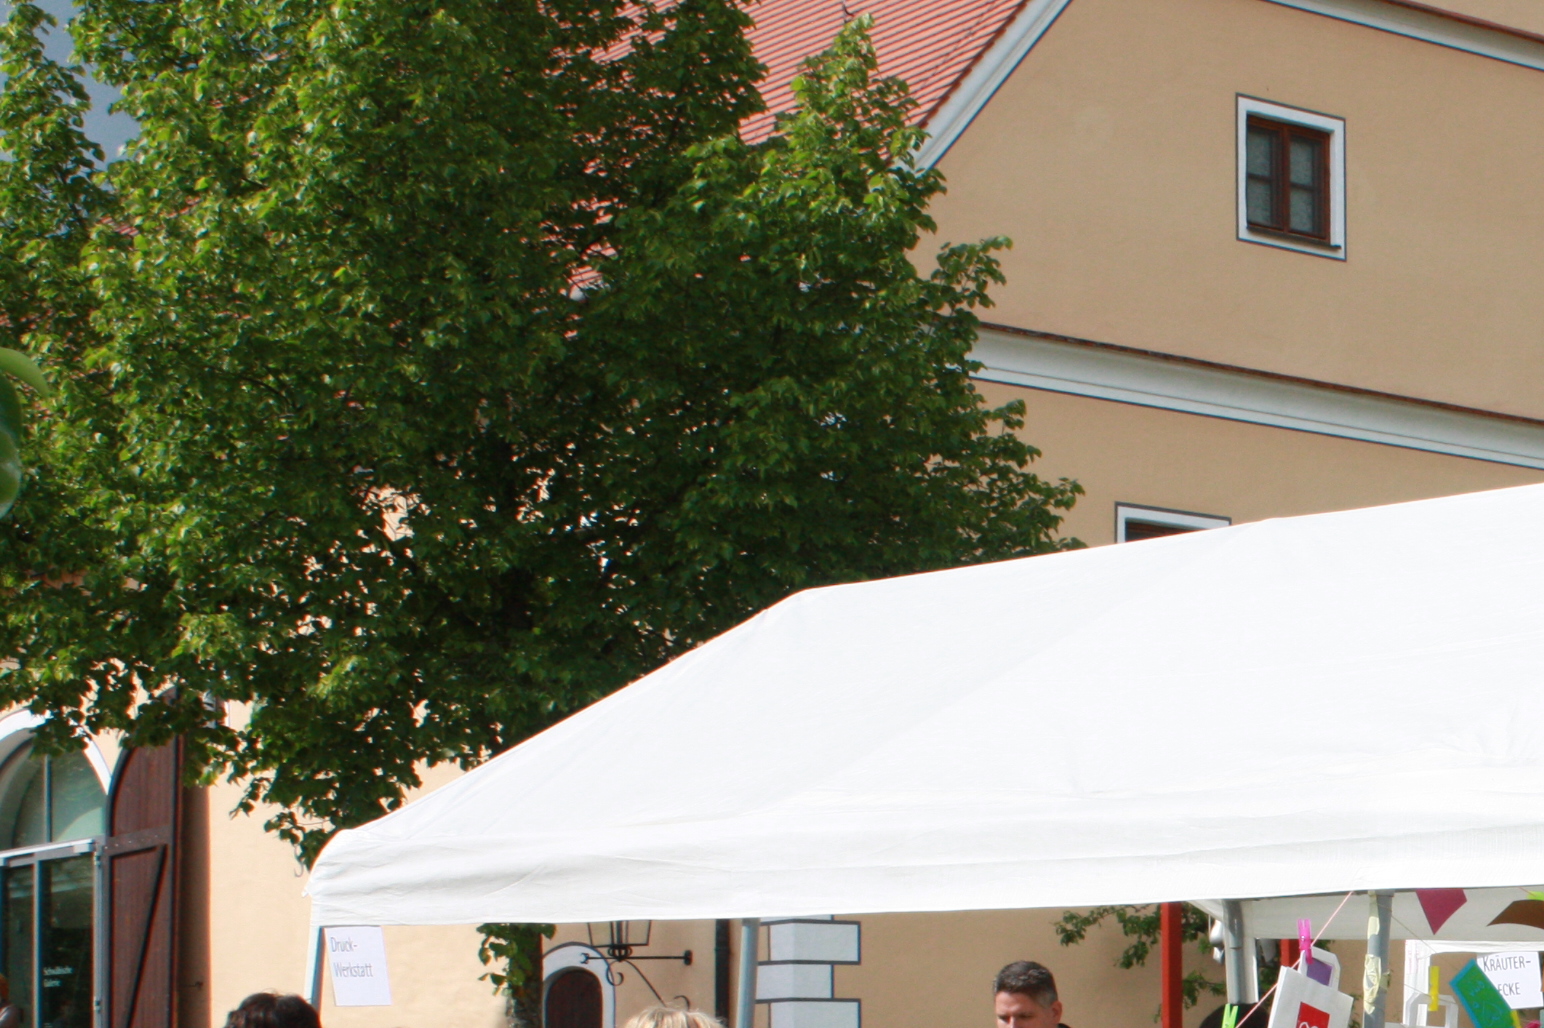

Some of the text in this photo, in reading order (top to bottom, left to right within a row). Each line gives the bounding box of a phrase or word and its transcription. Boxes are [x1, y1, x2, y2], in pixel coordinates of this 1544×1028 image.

[330, 936, 358, 952] Druck-
[333, 962, 373, 978] Werkstatt
[1483, 954, 1531, 972] KRÄUTER-
